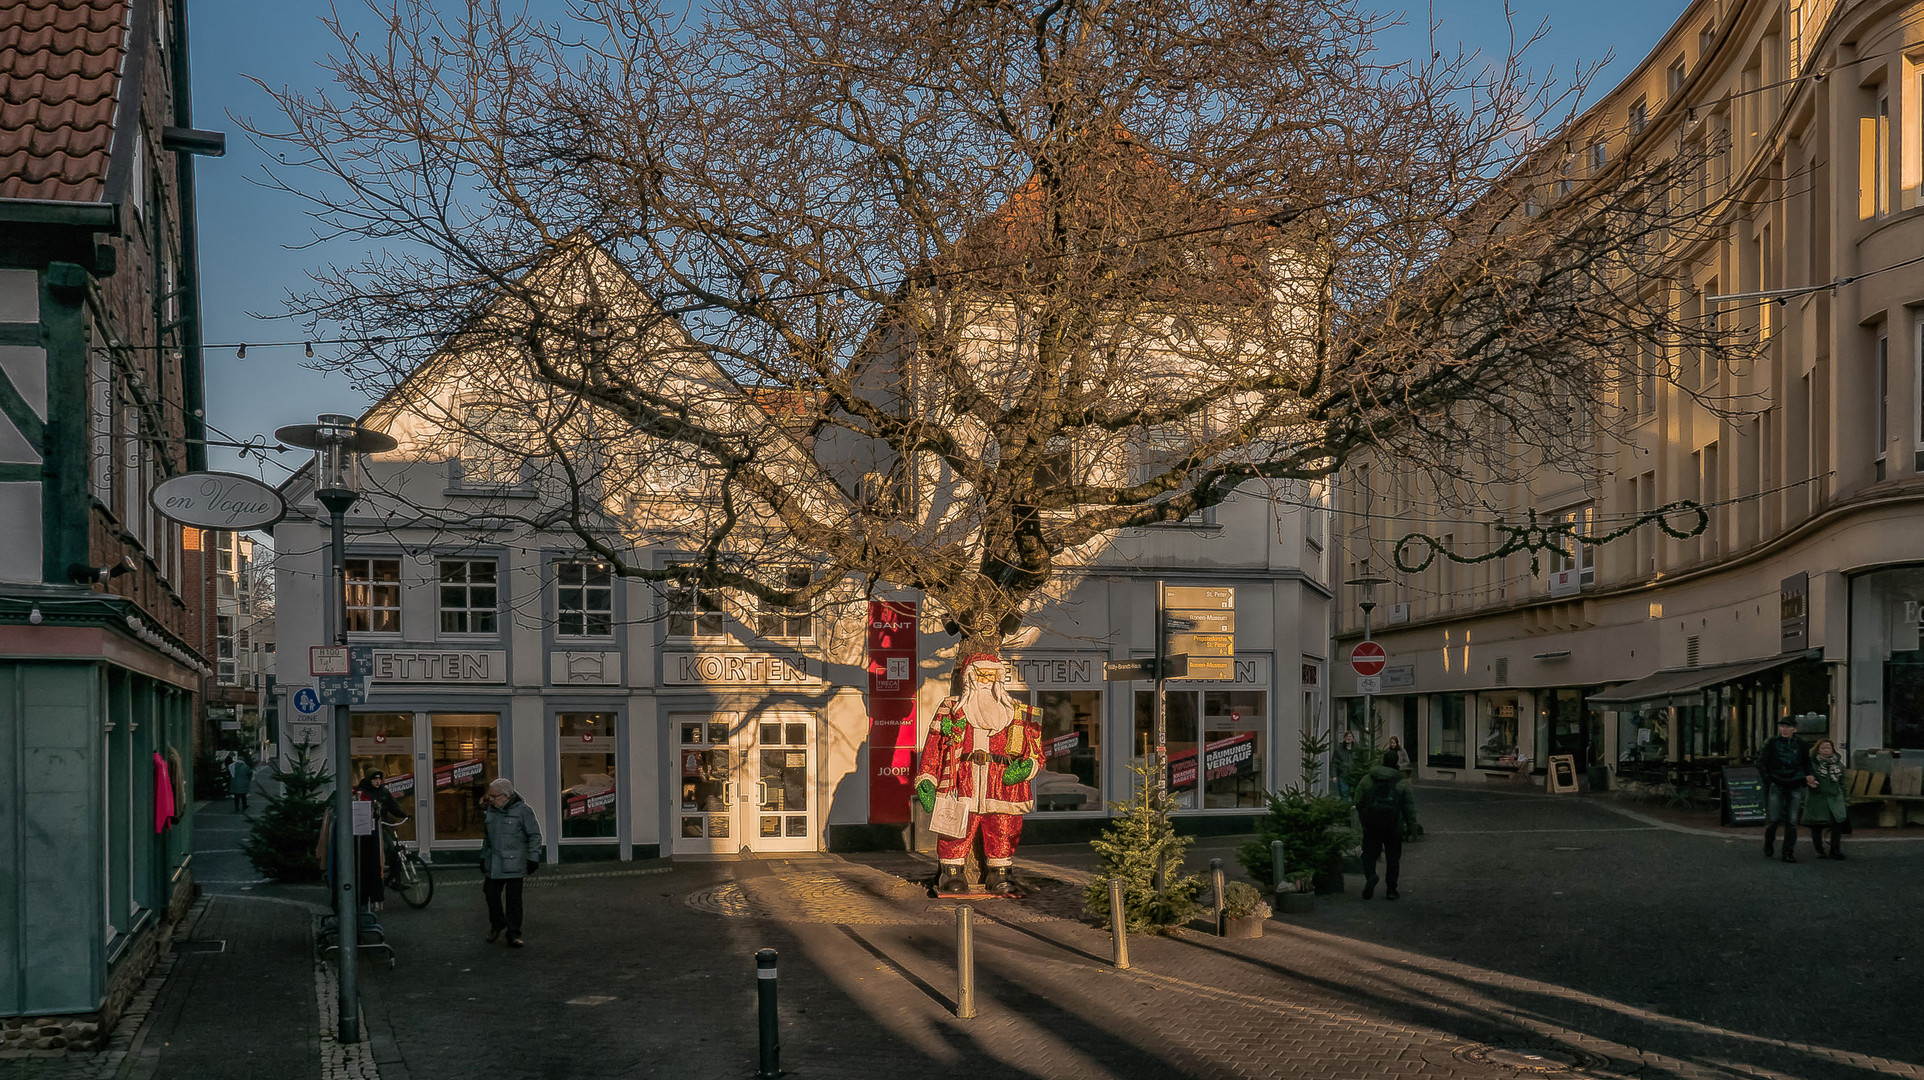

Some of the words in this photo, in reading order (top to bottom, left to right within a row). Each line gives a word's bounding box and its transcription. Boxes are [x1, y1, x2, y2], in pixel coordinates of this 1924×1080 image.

[165, 496, 195, 509] en
[200, 477, 271, 524] Vogue
[319, 648, 340, 656] H100
[351, 651, 356, 659] S
[375, 653, 489, 678] ETTEN
[679, 656, 807, 681] KORTEN
[1000, 659, 1091, 682] ETTEN
[343, 681, 348, 689] S
[1206, 742, 1252, 762] RÄUMUNGS
[1206, 750, 1252, 770] VERKAUF
[877, 767, 910, 776] JOOP!
